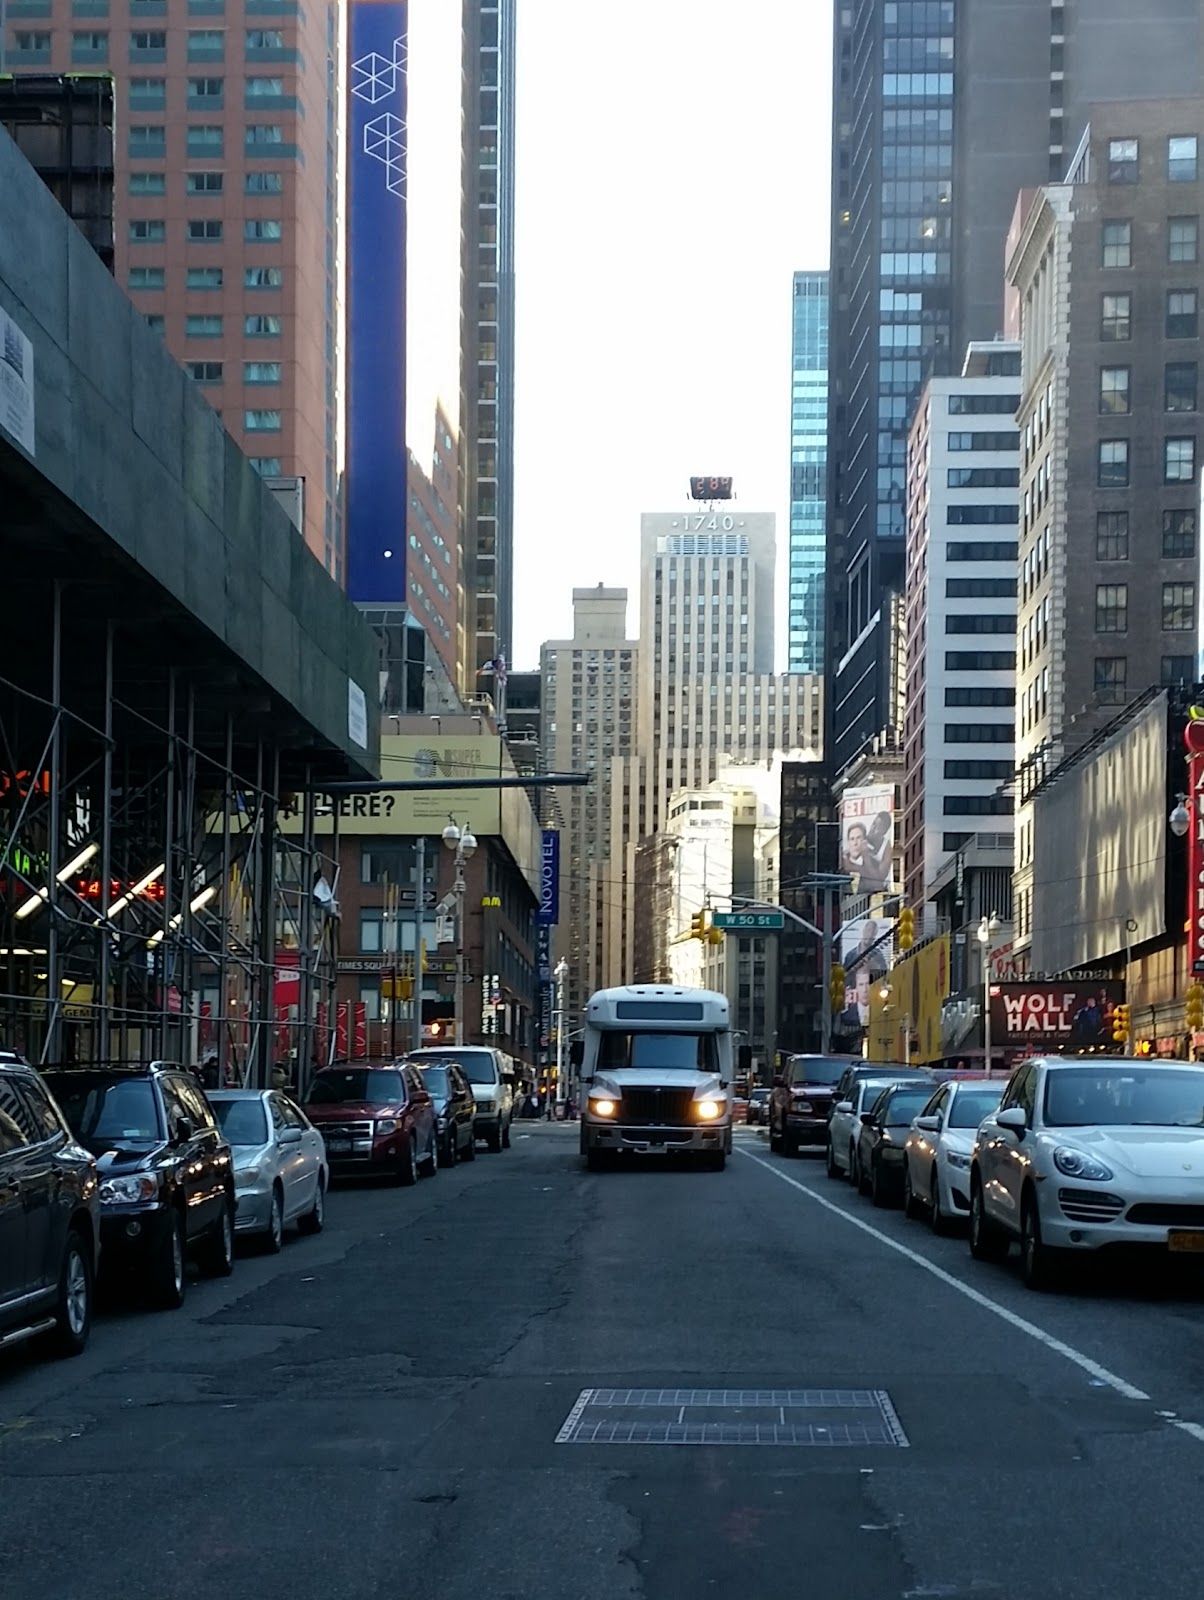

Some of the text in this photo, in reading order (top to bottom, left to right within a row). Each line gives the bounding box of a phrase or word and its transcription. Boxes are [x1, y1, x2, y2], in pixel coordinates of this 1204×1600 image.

[683, 515, 735, 531] 1740
[539, 838, 554, 913] NOVOTEL
[726, 915, 770, 925] W 50 St
[1003, 993, 1076, 1013] WOLF
[1007, 1013, 1072, 1031] HALL
